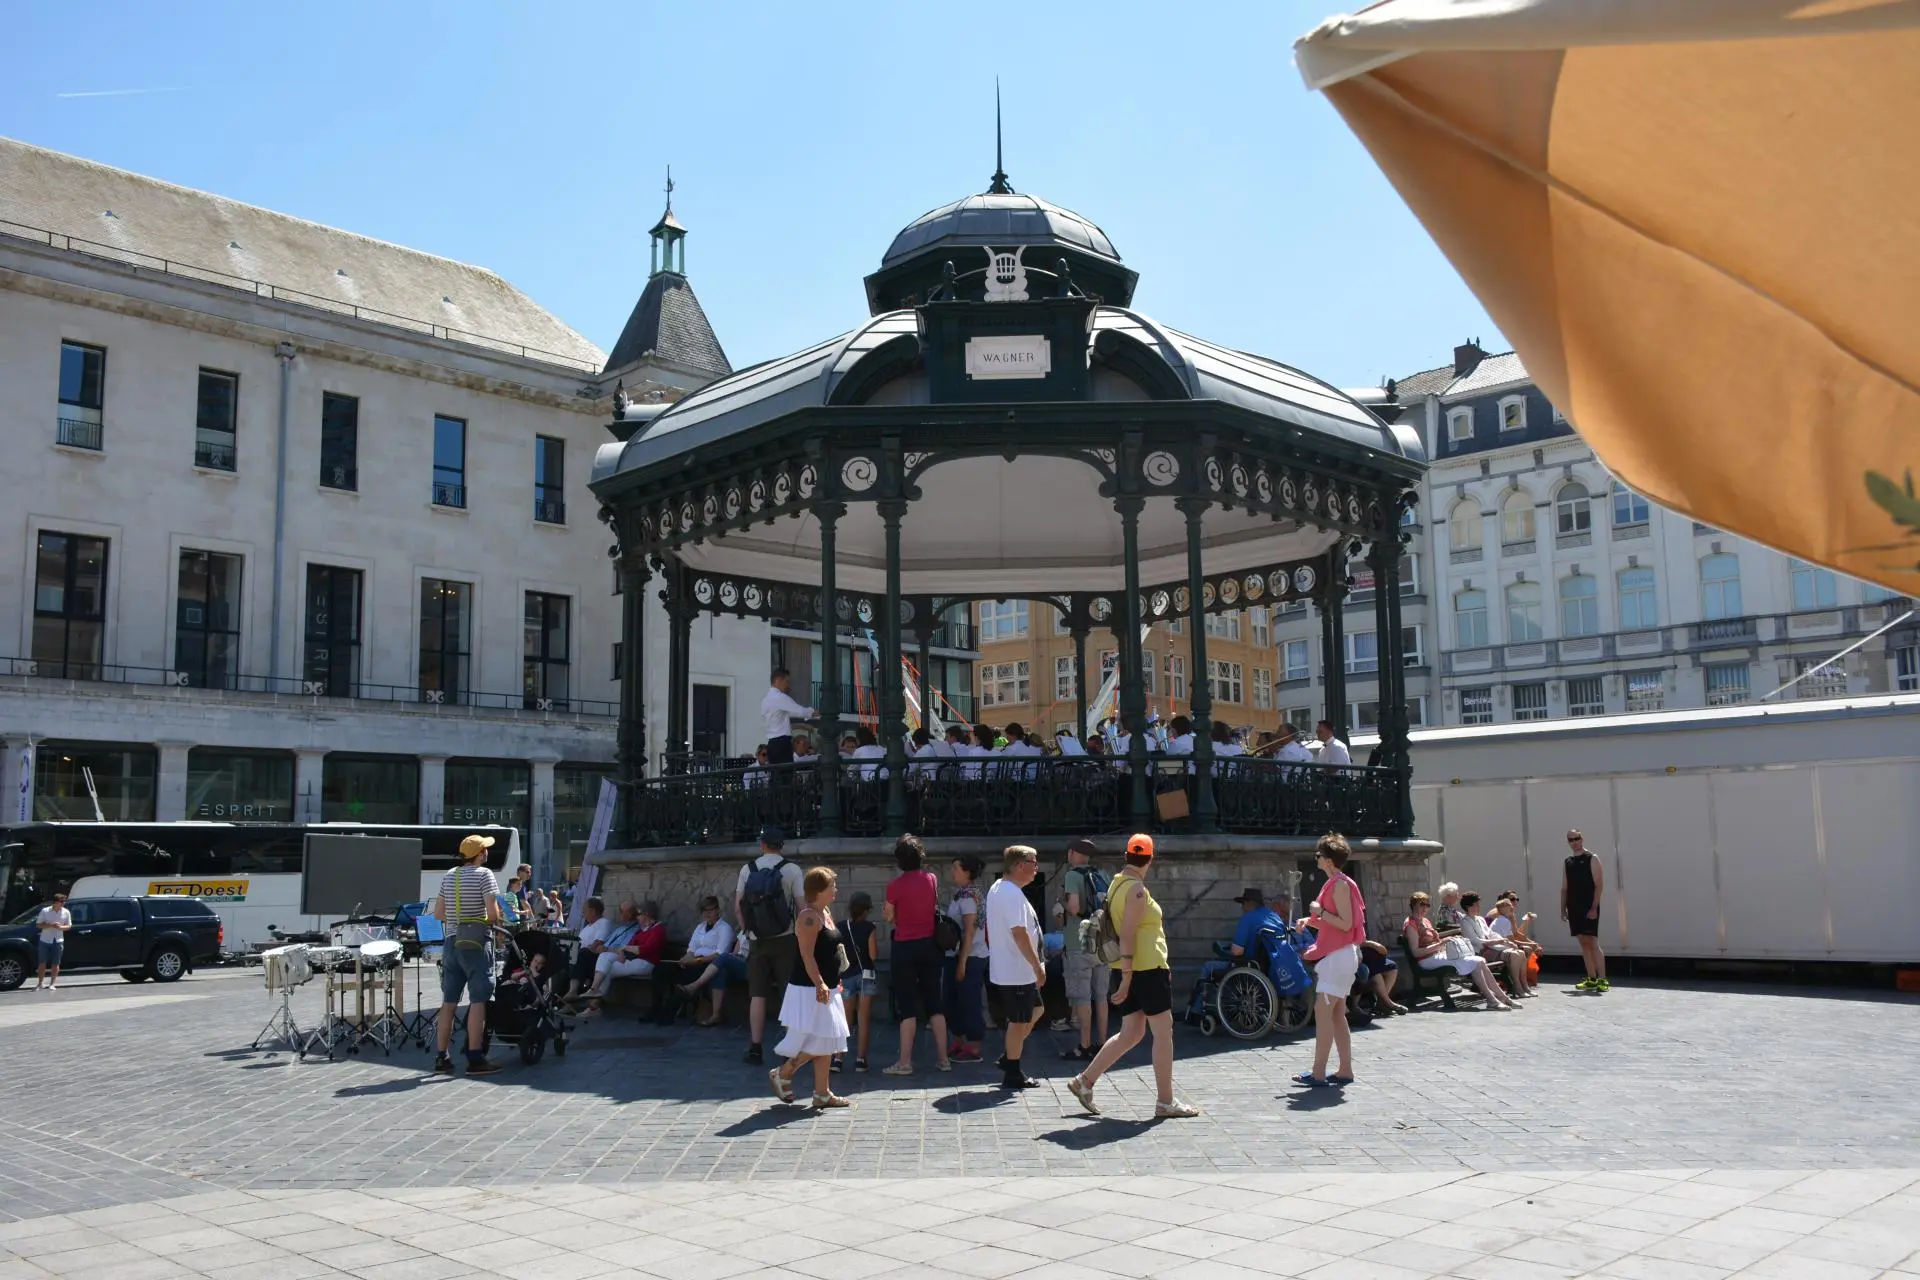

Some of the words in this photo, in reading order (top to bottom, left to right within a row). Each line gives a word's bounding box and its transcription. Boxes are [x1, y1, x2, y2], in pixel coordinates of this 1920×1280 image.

[983, 352, 1034, 363] WAGNER
[200, 803, 276, 817] ESPRIT
[453, 808, 514, 820] ESPRIT
[154, 884, 182, 895] Ter
[188, 884, 243, 897] Doest
